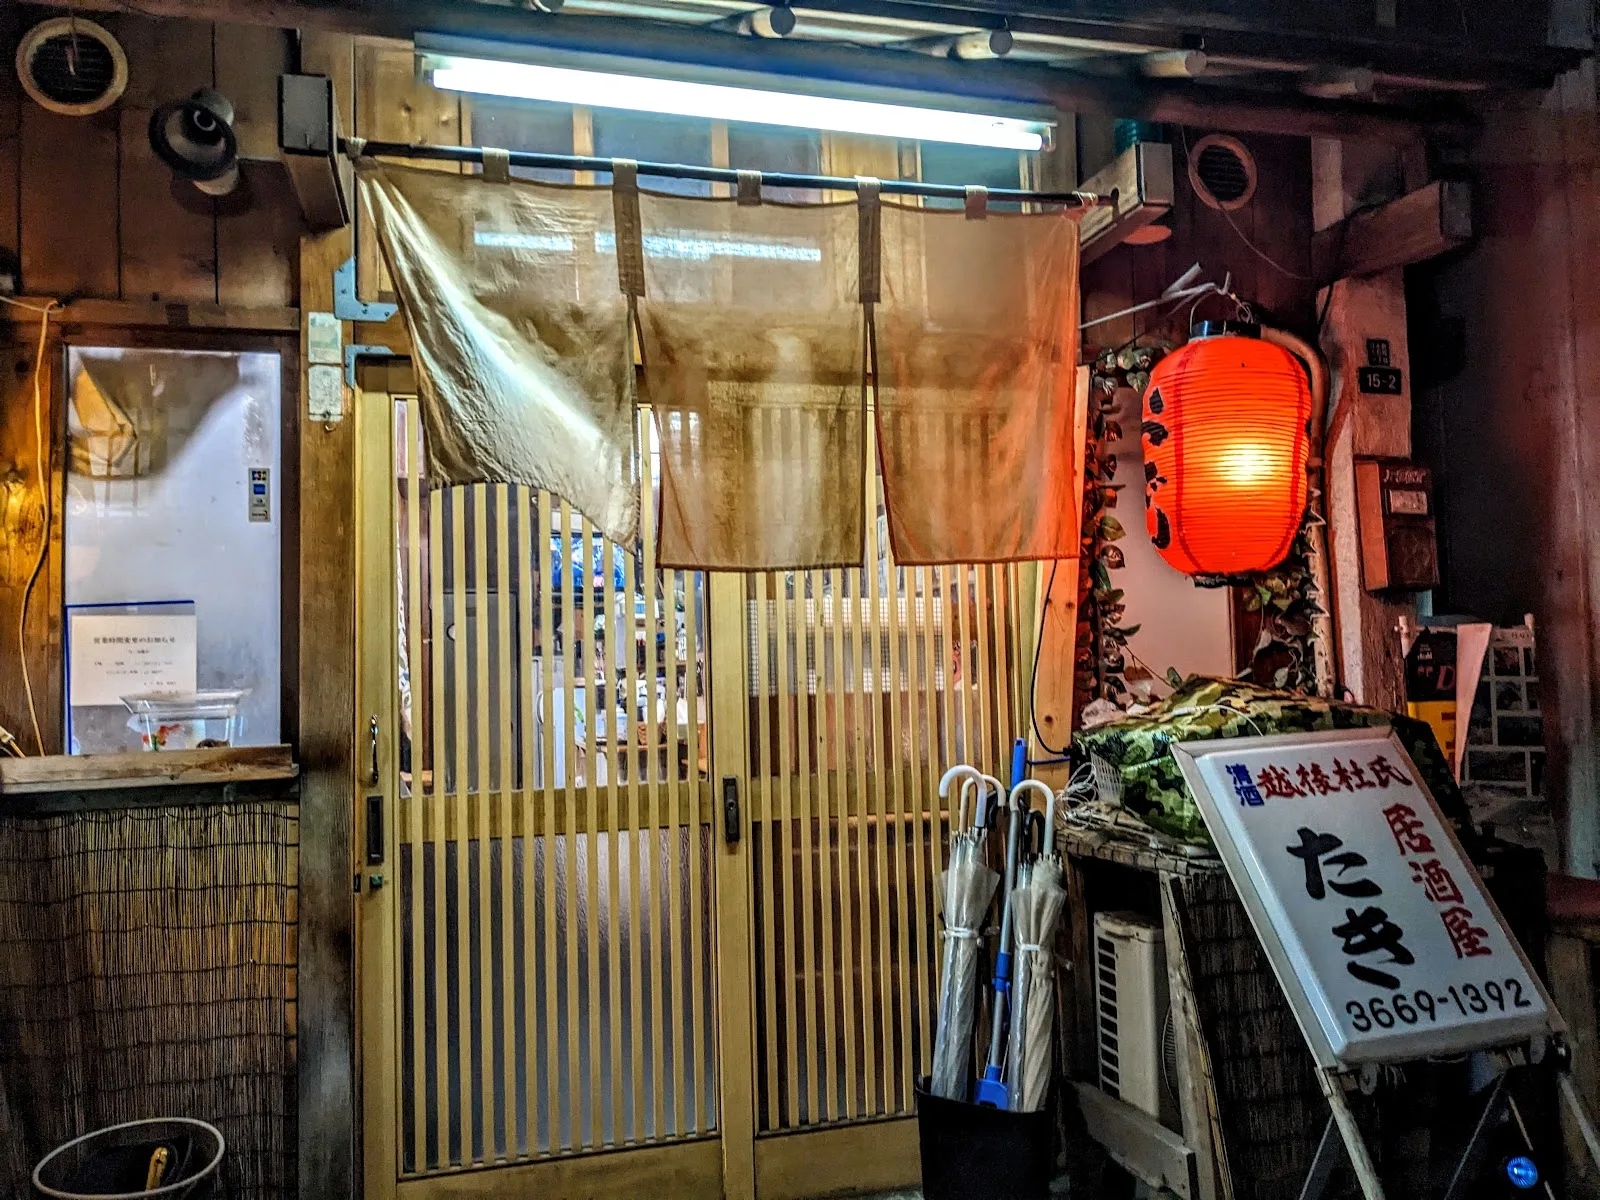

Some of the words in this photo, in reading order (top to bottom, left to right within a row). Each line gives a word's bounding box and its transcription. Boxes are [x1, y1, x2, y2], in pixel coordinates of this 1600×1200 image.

[1366, 373, 1397, 389] 15-2
[1225, 763, 1265, 806] 清酒
[1257, 754, 1412, 799] 越後杜氏
[1382, 803, 1492, 959] 居酒屋
[1286, 827, 1415, 990] たき
[1345, 978, 1531, 1032] 3669-1392
